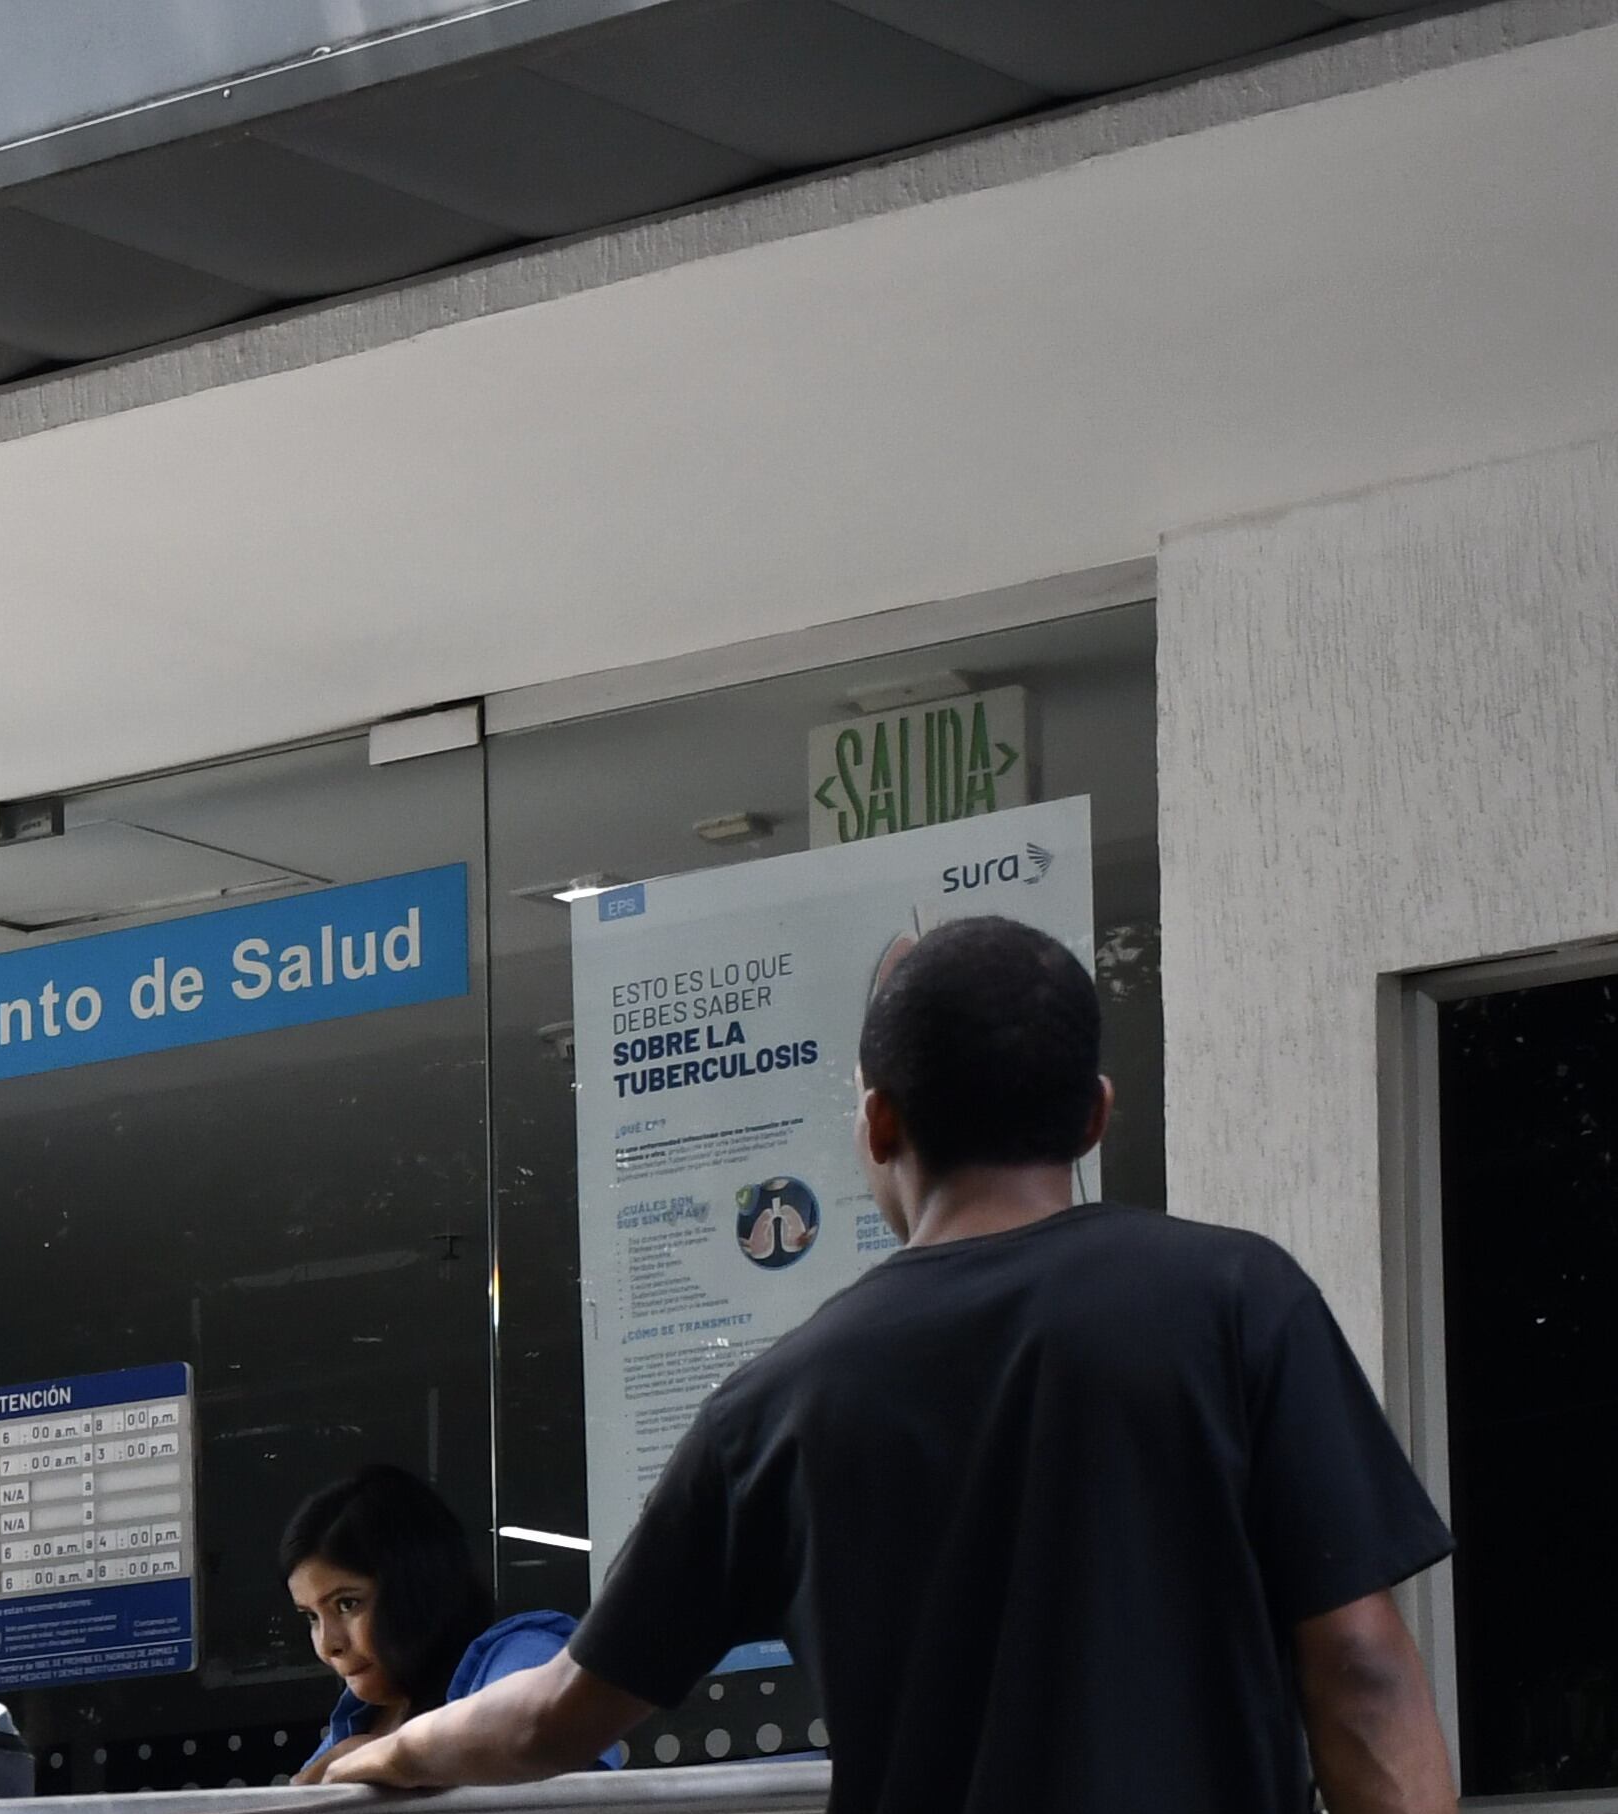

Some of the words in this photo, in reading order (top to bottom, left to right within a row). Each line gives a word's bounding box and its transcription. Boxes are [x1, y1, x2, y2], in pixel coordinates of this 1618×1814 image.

[835, 702, 996, 843] SALIDA
[943, 854, 1019, 893] sura
[607, 898, 636, 916] EPS
[130, 957, 204, 1019] de
[232, 907, 421, 1000] Salud
[613, 977, 667, 1008] ESTO
[674, 970, 703, 996] ES
[710, 964, 739, 989] LO
[746, 953, 793, 984] QUE
[613, 1001, 687, 1035] DEBES
[693, 986, 772, 1020] SABER
[613, 1028, 700, 1066] SOBRE
[707, 1021, 745, 1049] LA
[613, 1039, 819, 1098] TUBERCULOSIS
[679, 1313, 753, 1332] TRANSMITE?
[55, 1428, 78, 1439] a.m.
[84, 1422, 90, 1433] a
[151, 1413, 176, 1428] p.m.
[55, 1457, 78, 1467] a.m.
[84, 1451, 90, 1462] a
[151, 1443, 175, 1457] p.m.
[3, 1489, 24, 1502] N/A
[85, 1481, 91, 1491] a
[3, 1518, 25, 1531] N/A
[86, 1510, 92, 1519] a
[56, 1543, 81, 1554] a.m.
[86, 1538, 92, 1548] a
[155, 1530, 180, 1544] p.m.
[58, 1572, 82, 1583] a.m.
[87, 1568, 93, 1578] a
[152, 1560, 177, 1574] p.m.
